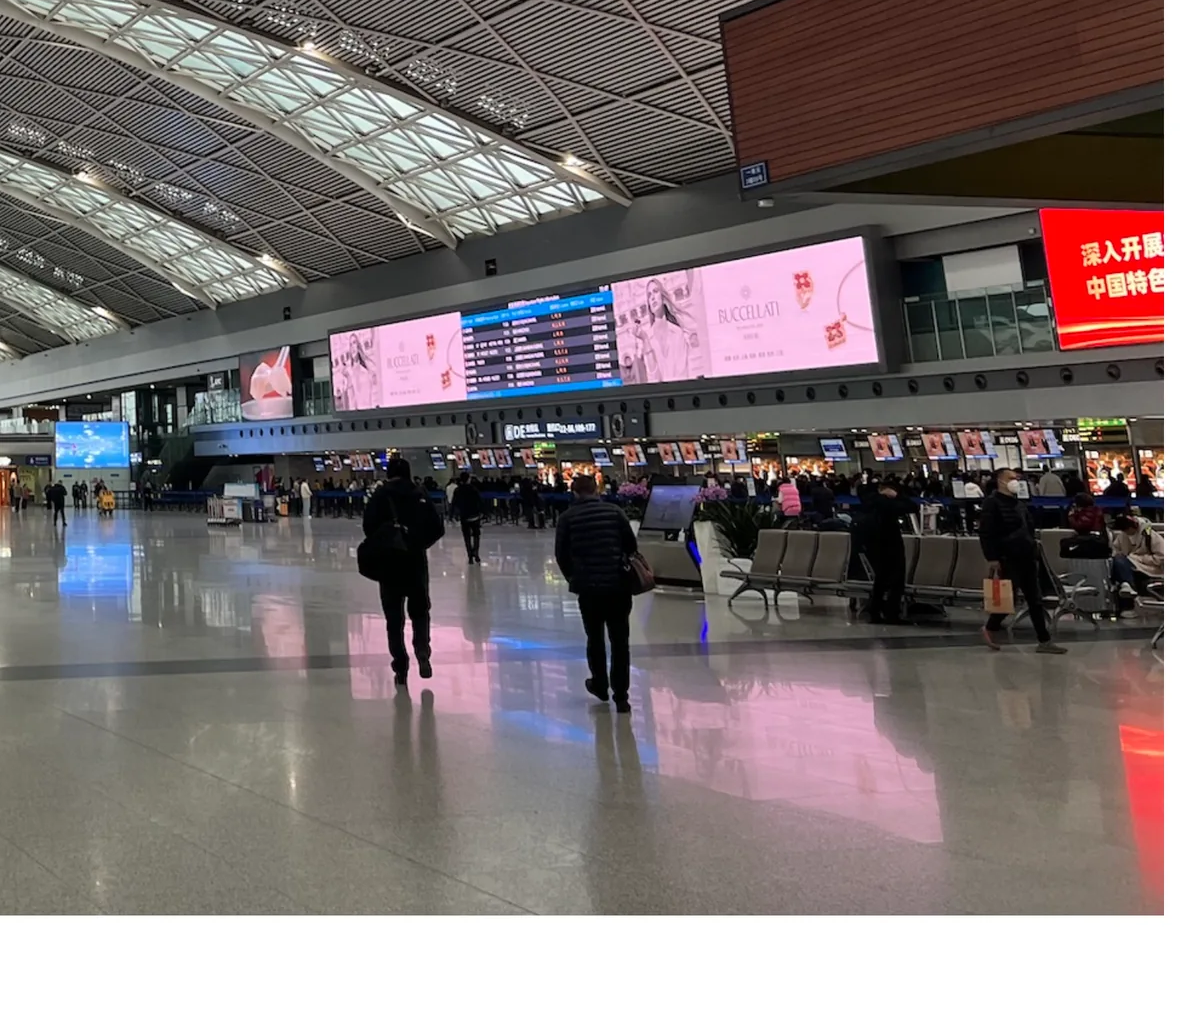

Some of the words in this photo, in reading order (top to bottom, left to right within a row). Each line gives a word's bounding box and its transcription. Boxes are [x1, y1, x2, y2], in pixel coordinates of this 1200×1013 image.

[1081, 232, 1164, 267] 深入开展
[1086, 268, 1164, 300] 中国特色
[718, 301, 780, 325] BUCCELLATI
